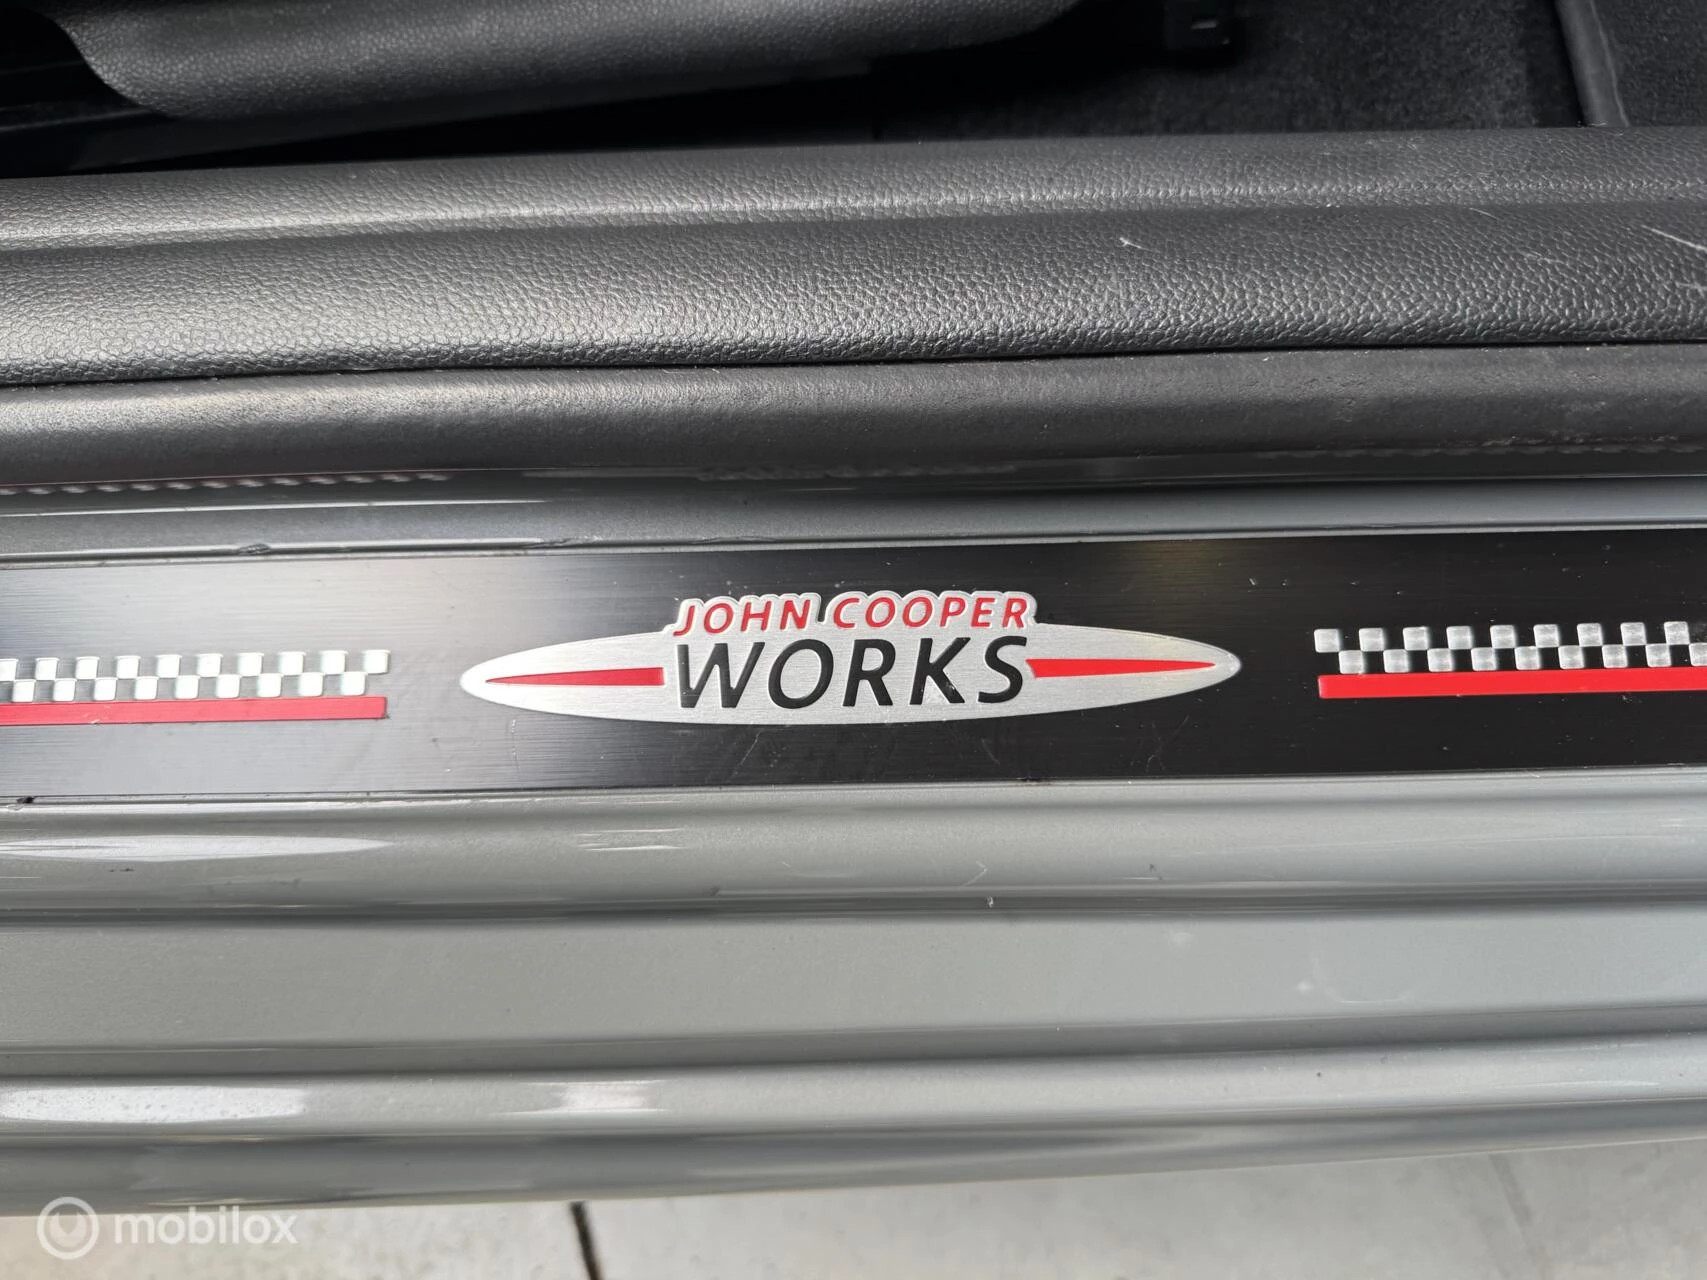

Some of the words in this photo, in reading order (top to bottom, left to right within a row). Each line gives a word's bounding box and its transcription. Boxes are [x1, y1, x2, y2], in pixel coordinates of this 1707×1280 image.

[673, 599, 812, 637] JOHN
[832, 596, 1028, 629] COOPER
[676, 635, 1028, 710] WORKS
